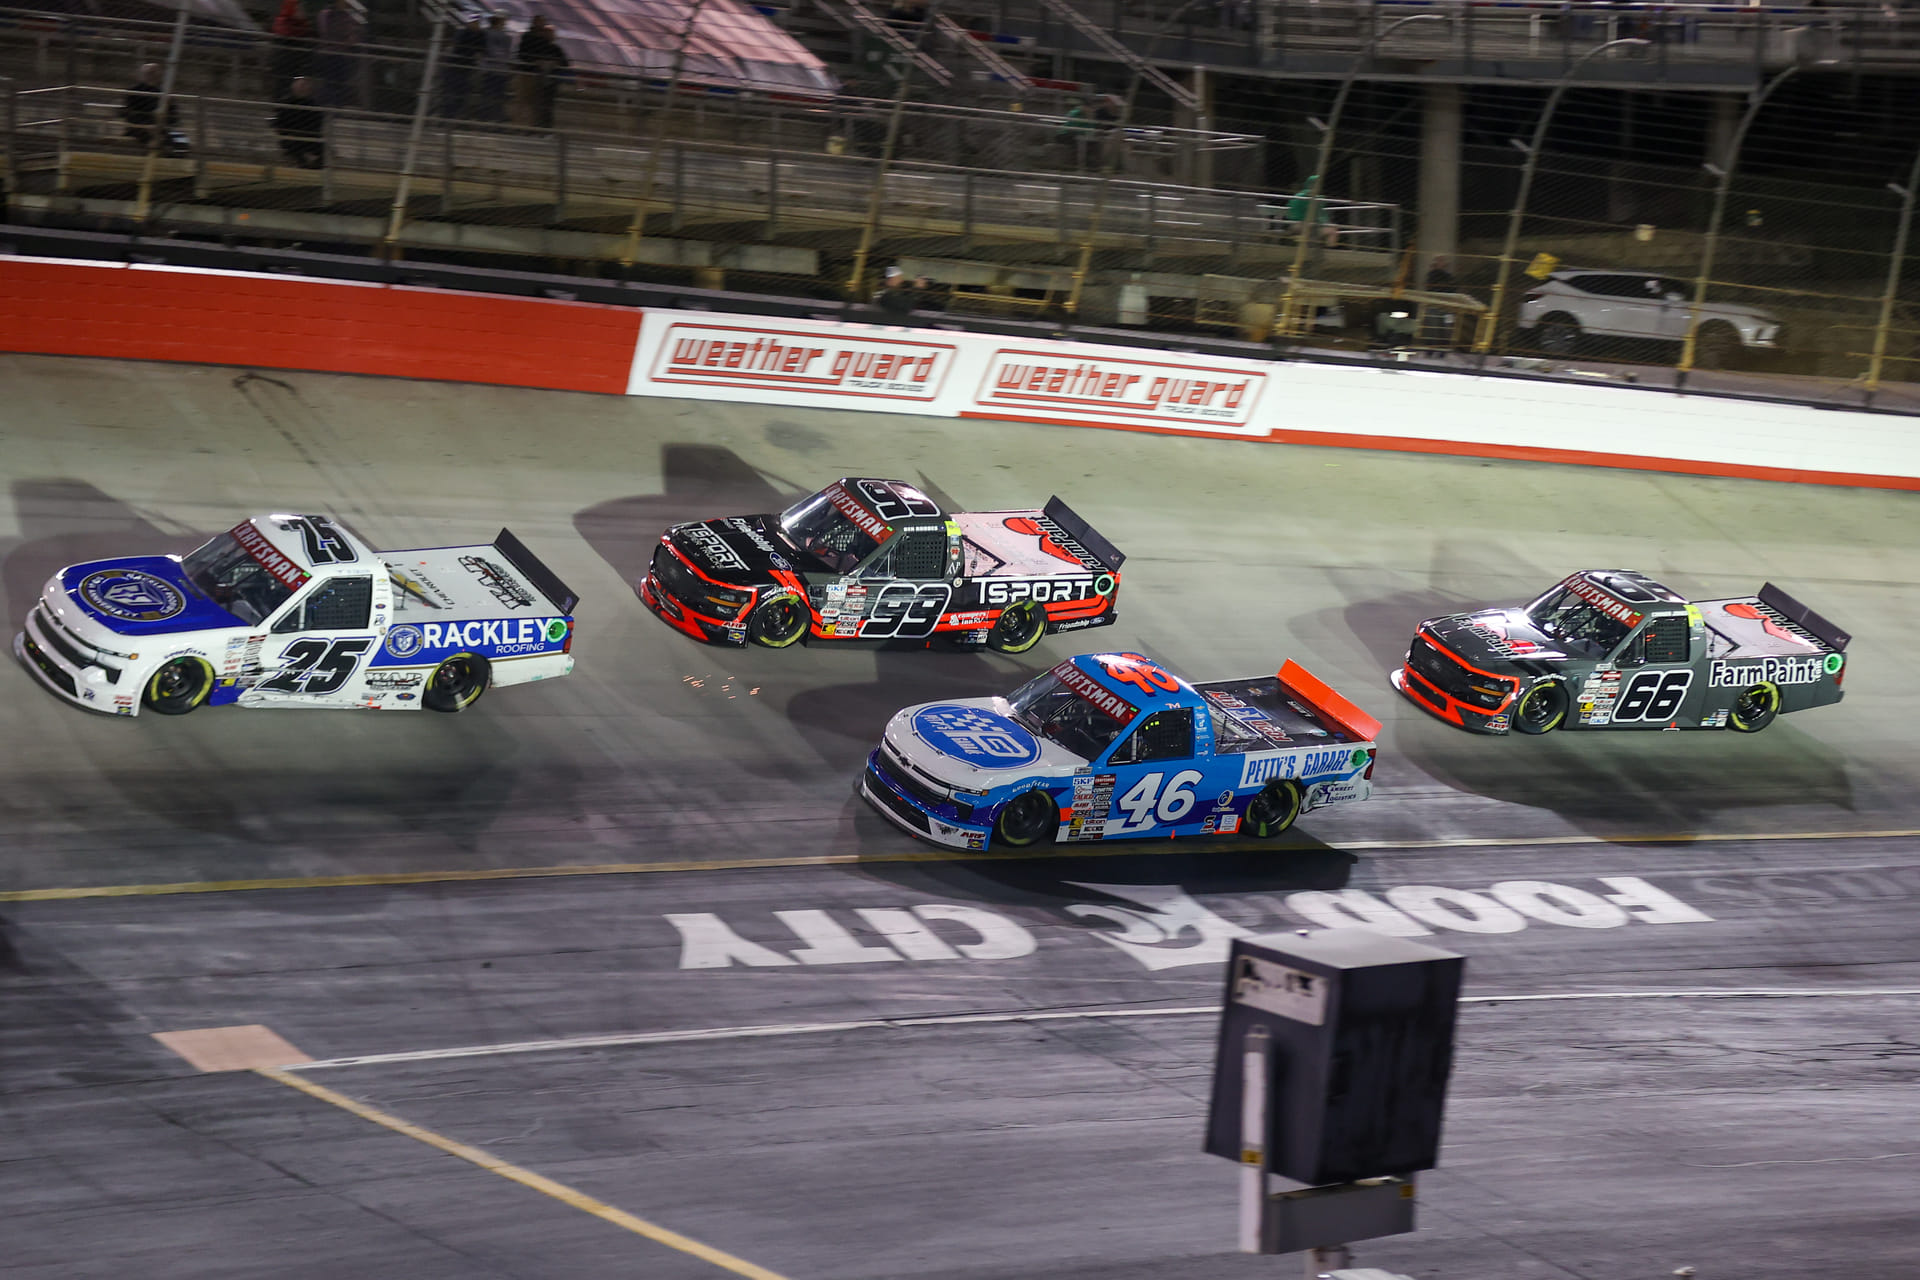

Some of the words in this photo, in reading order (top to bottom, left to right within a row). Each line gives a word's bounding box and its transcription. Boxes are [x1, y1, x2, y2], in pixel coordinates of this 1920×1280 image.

[672, 338, 826, 373] weather
[831, 350, 940, 385] guard
[997, 364, 1142, 398] weather
[1148, 377, 1250, 410] guard
[826, 484, 884, 536] CRAFTSMAN
[233, 524, 302, 585] CRAFTSMAN
[288, 516, 359, 567] 25
[859, 583, 952, 638] 99
[1566, 576, 1632, 621] CRAFTSMAN
[424, 618, 552, 649] RACKLEY
[496, 643, 545, 654] ROOFING
[254, 636, 376, 695] 25
[1053, 663, 1126, 718] CRAFTSMAN
[1106, 653, 1180, 697] 46
[1709, 657, 1818, 687] FarmPaint
[1611, 669, 1694, 722] 66
[1012, 779, 1050, 793] GOODYEAR
[1245, 755, 1296, 784] PETTY'S
[1302, 750, 1352, 776] GARAGE
[1119, 769, 1205, 825] 46
[1285, 876, 1717, 937] FOOD
[662, 904, 1038, 969] CITY
